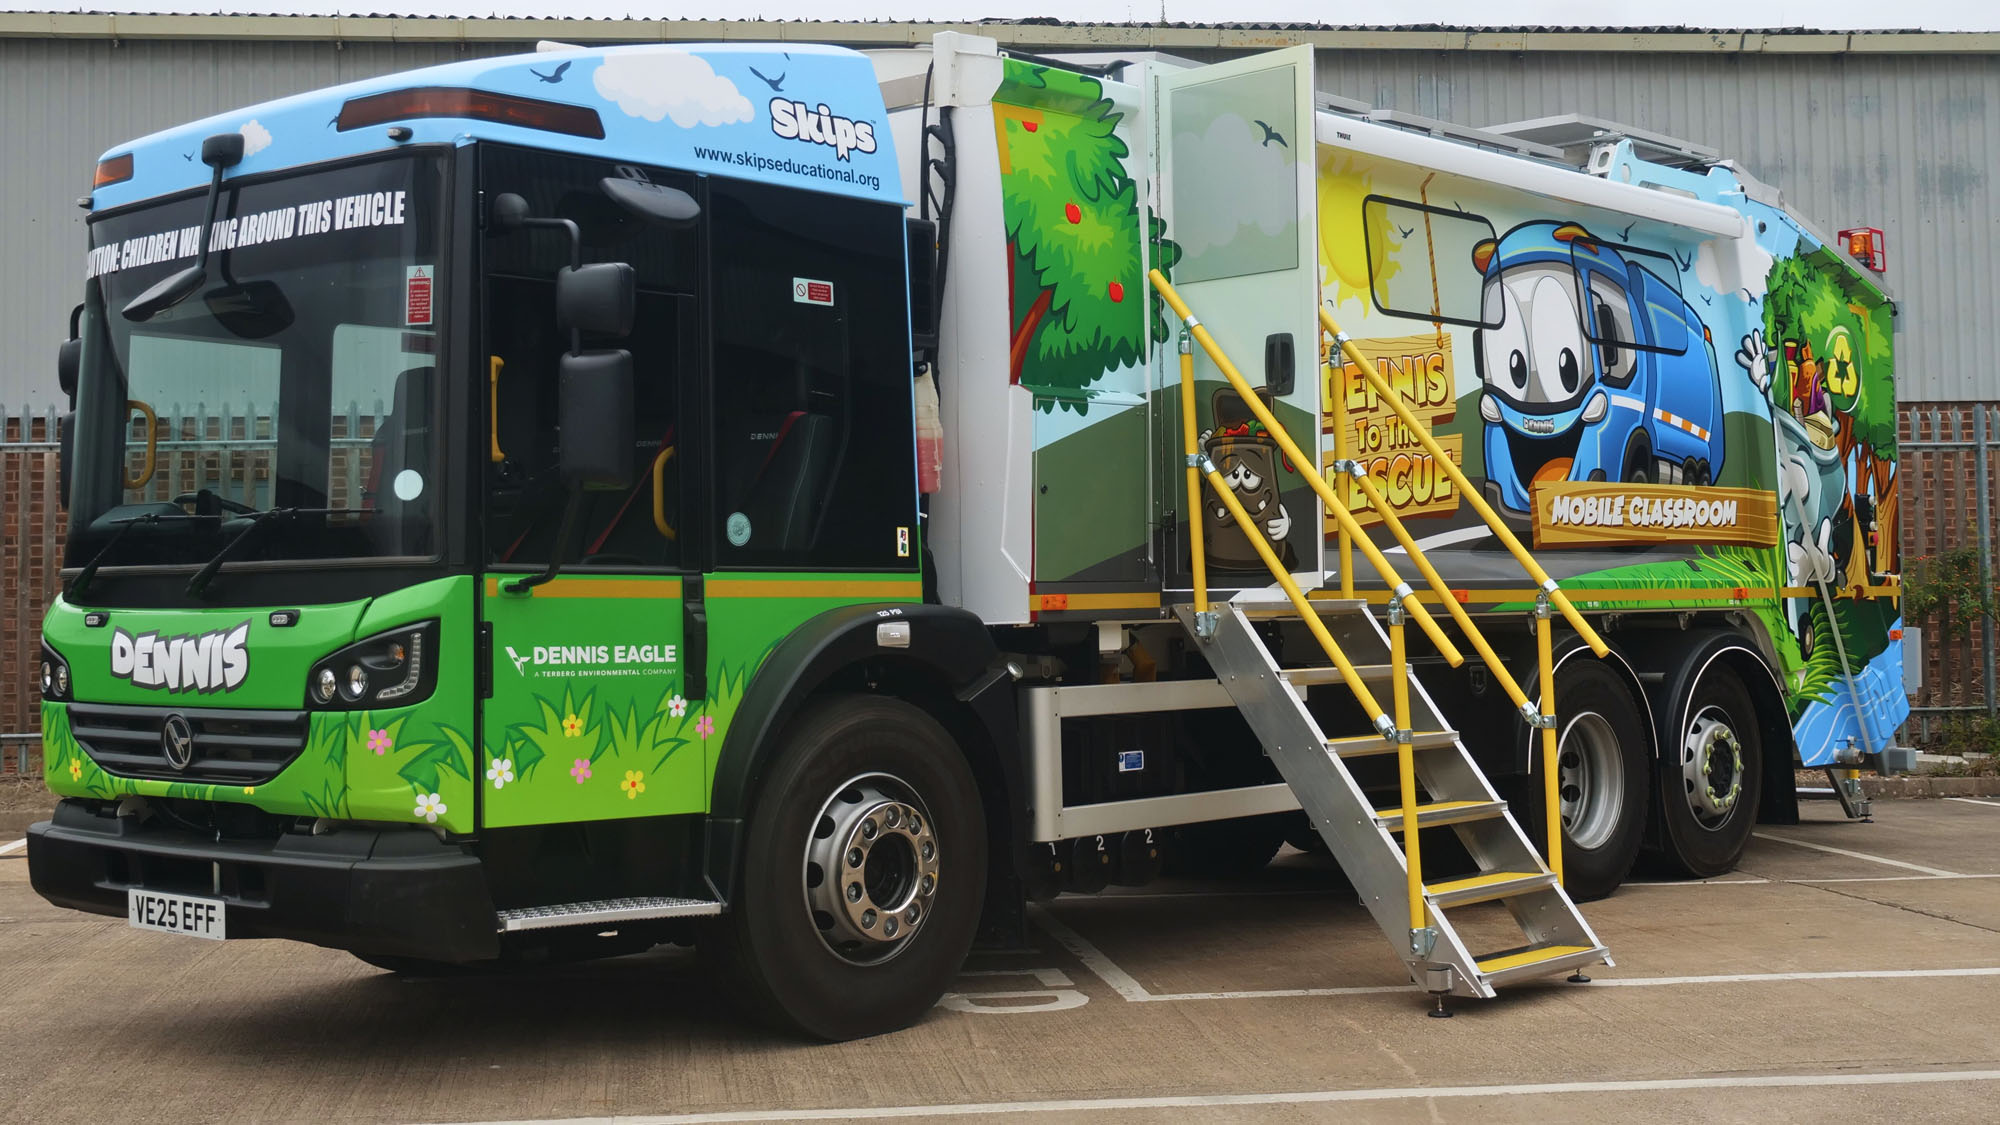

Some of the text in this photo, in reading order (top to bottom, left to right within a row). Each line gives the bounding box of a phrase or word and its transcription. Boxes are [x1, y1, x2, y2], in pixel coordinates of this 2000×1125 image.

[769, 97, 877, 162] Skips
[694, 146, 880, 191] www.skipseducational.org
[86, 191, 406, 279] AUTION: CHILDREN WAKING AROUND THIS VEHICLE
[1551, 495, 1737, 529] MOBILE CLASSROOM
[110, 617, 253, 696] DENNIS
[533, 645, 677, 665] DENNIS EAGLE
[578, 669, 641, 677] ENVIRONMENTAL
[642, 668, 677, 676] COMPANY
[1096, 835, 1105, 851] 2
[1144, 828, 1154, 844] 2
[135, 894, 217, 934] VE25 EFF
